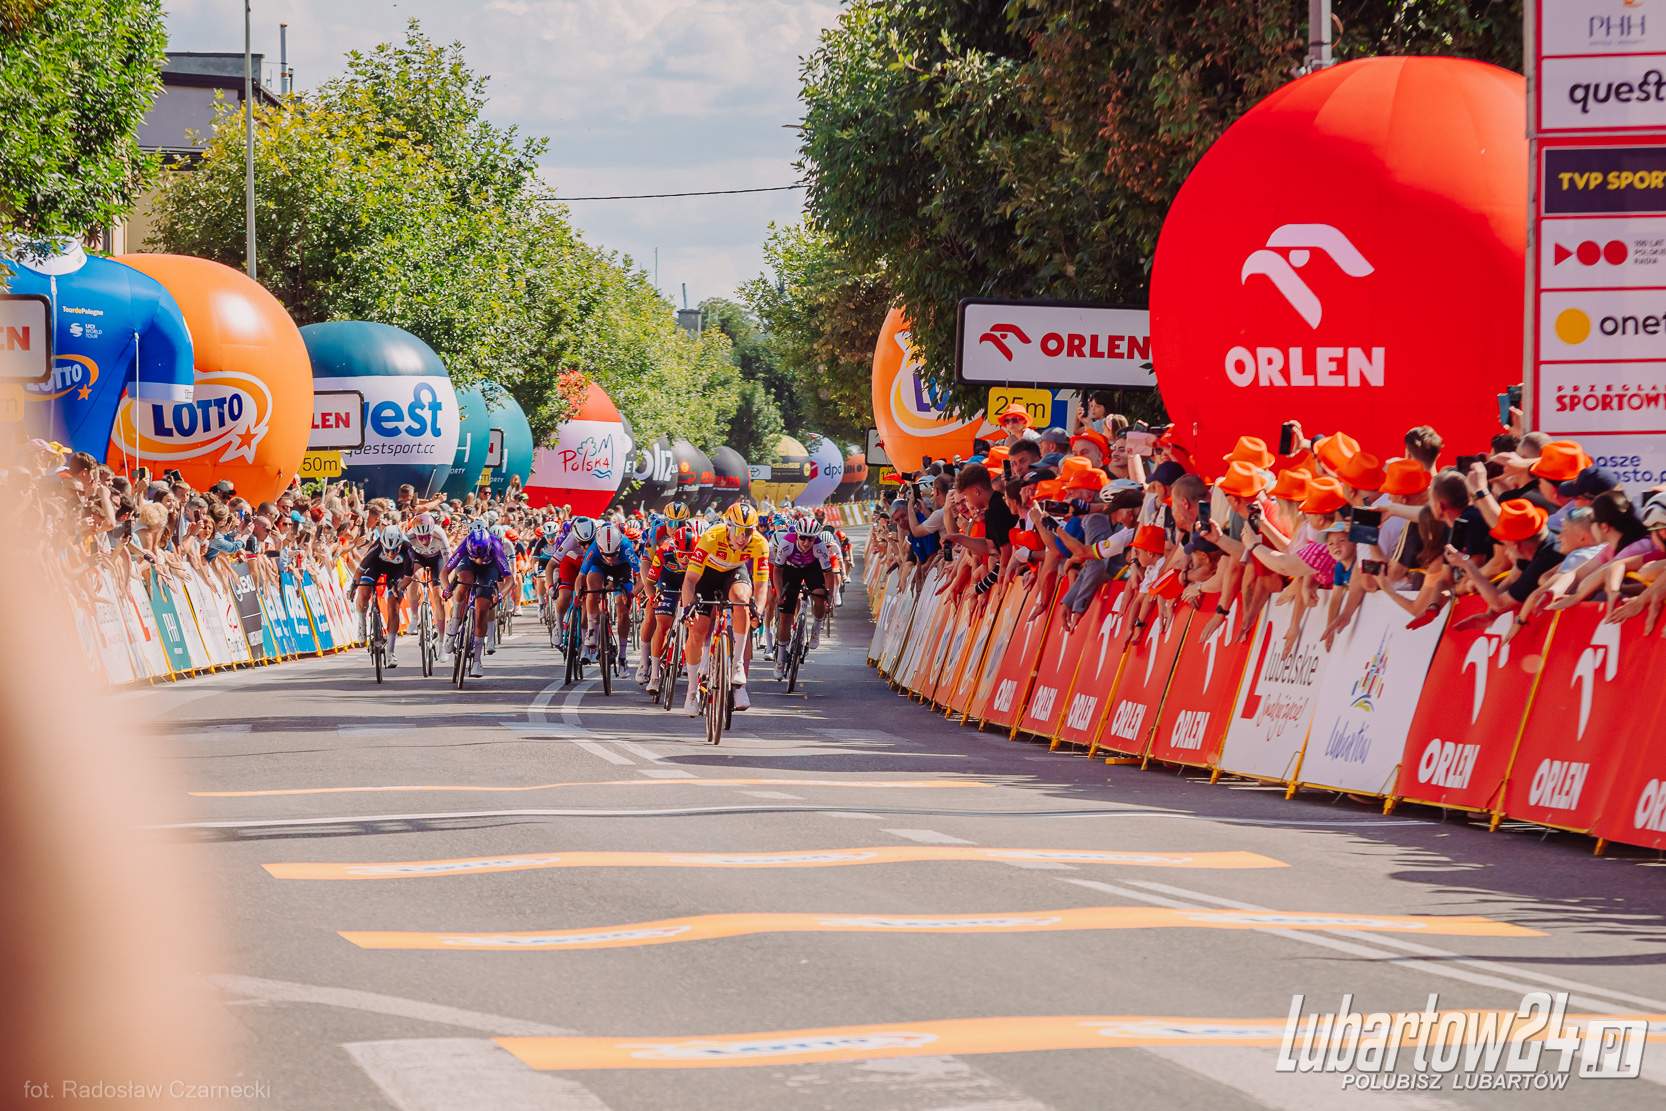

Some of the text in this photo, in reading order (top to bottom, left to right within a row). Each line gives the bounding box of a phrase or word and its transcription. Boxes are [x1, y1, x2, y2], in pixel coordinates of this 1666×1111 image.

[1588, 14, 1647, 38] PHH
[1557, 172, 1604, 191] TVP
[1039, 332, 1150, 360] ORLEN
[1224, 345, 1386, 388] ORLEN
[151, 392, 244, 438] LOTTO
[311, 412, 351, 429] LEN
[1555, 393, 1666, 413] SPORTOW
[1596, 454, 1641, 468] asze
[1067, 692, 1098, 732] ORLEN
[1110, 699, 1148, 742] ORLEN
[1170, 708, 1211, 750] ORLEN
[1417, 738, 1481, 790] ORLEN
[1528, 757, 1590, 811] ORLEN
